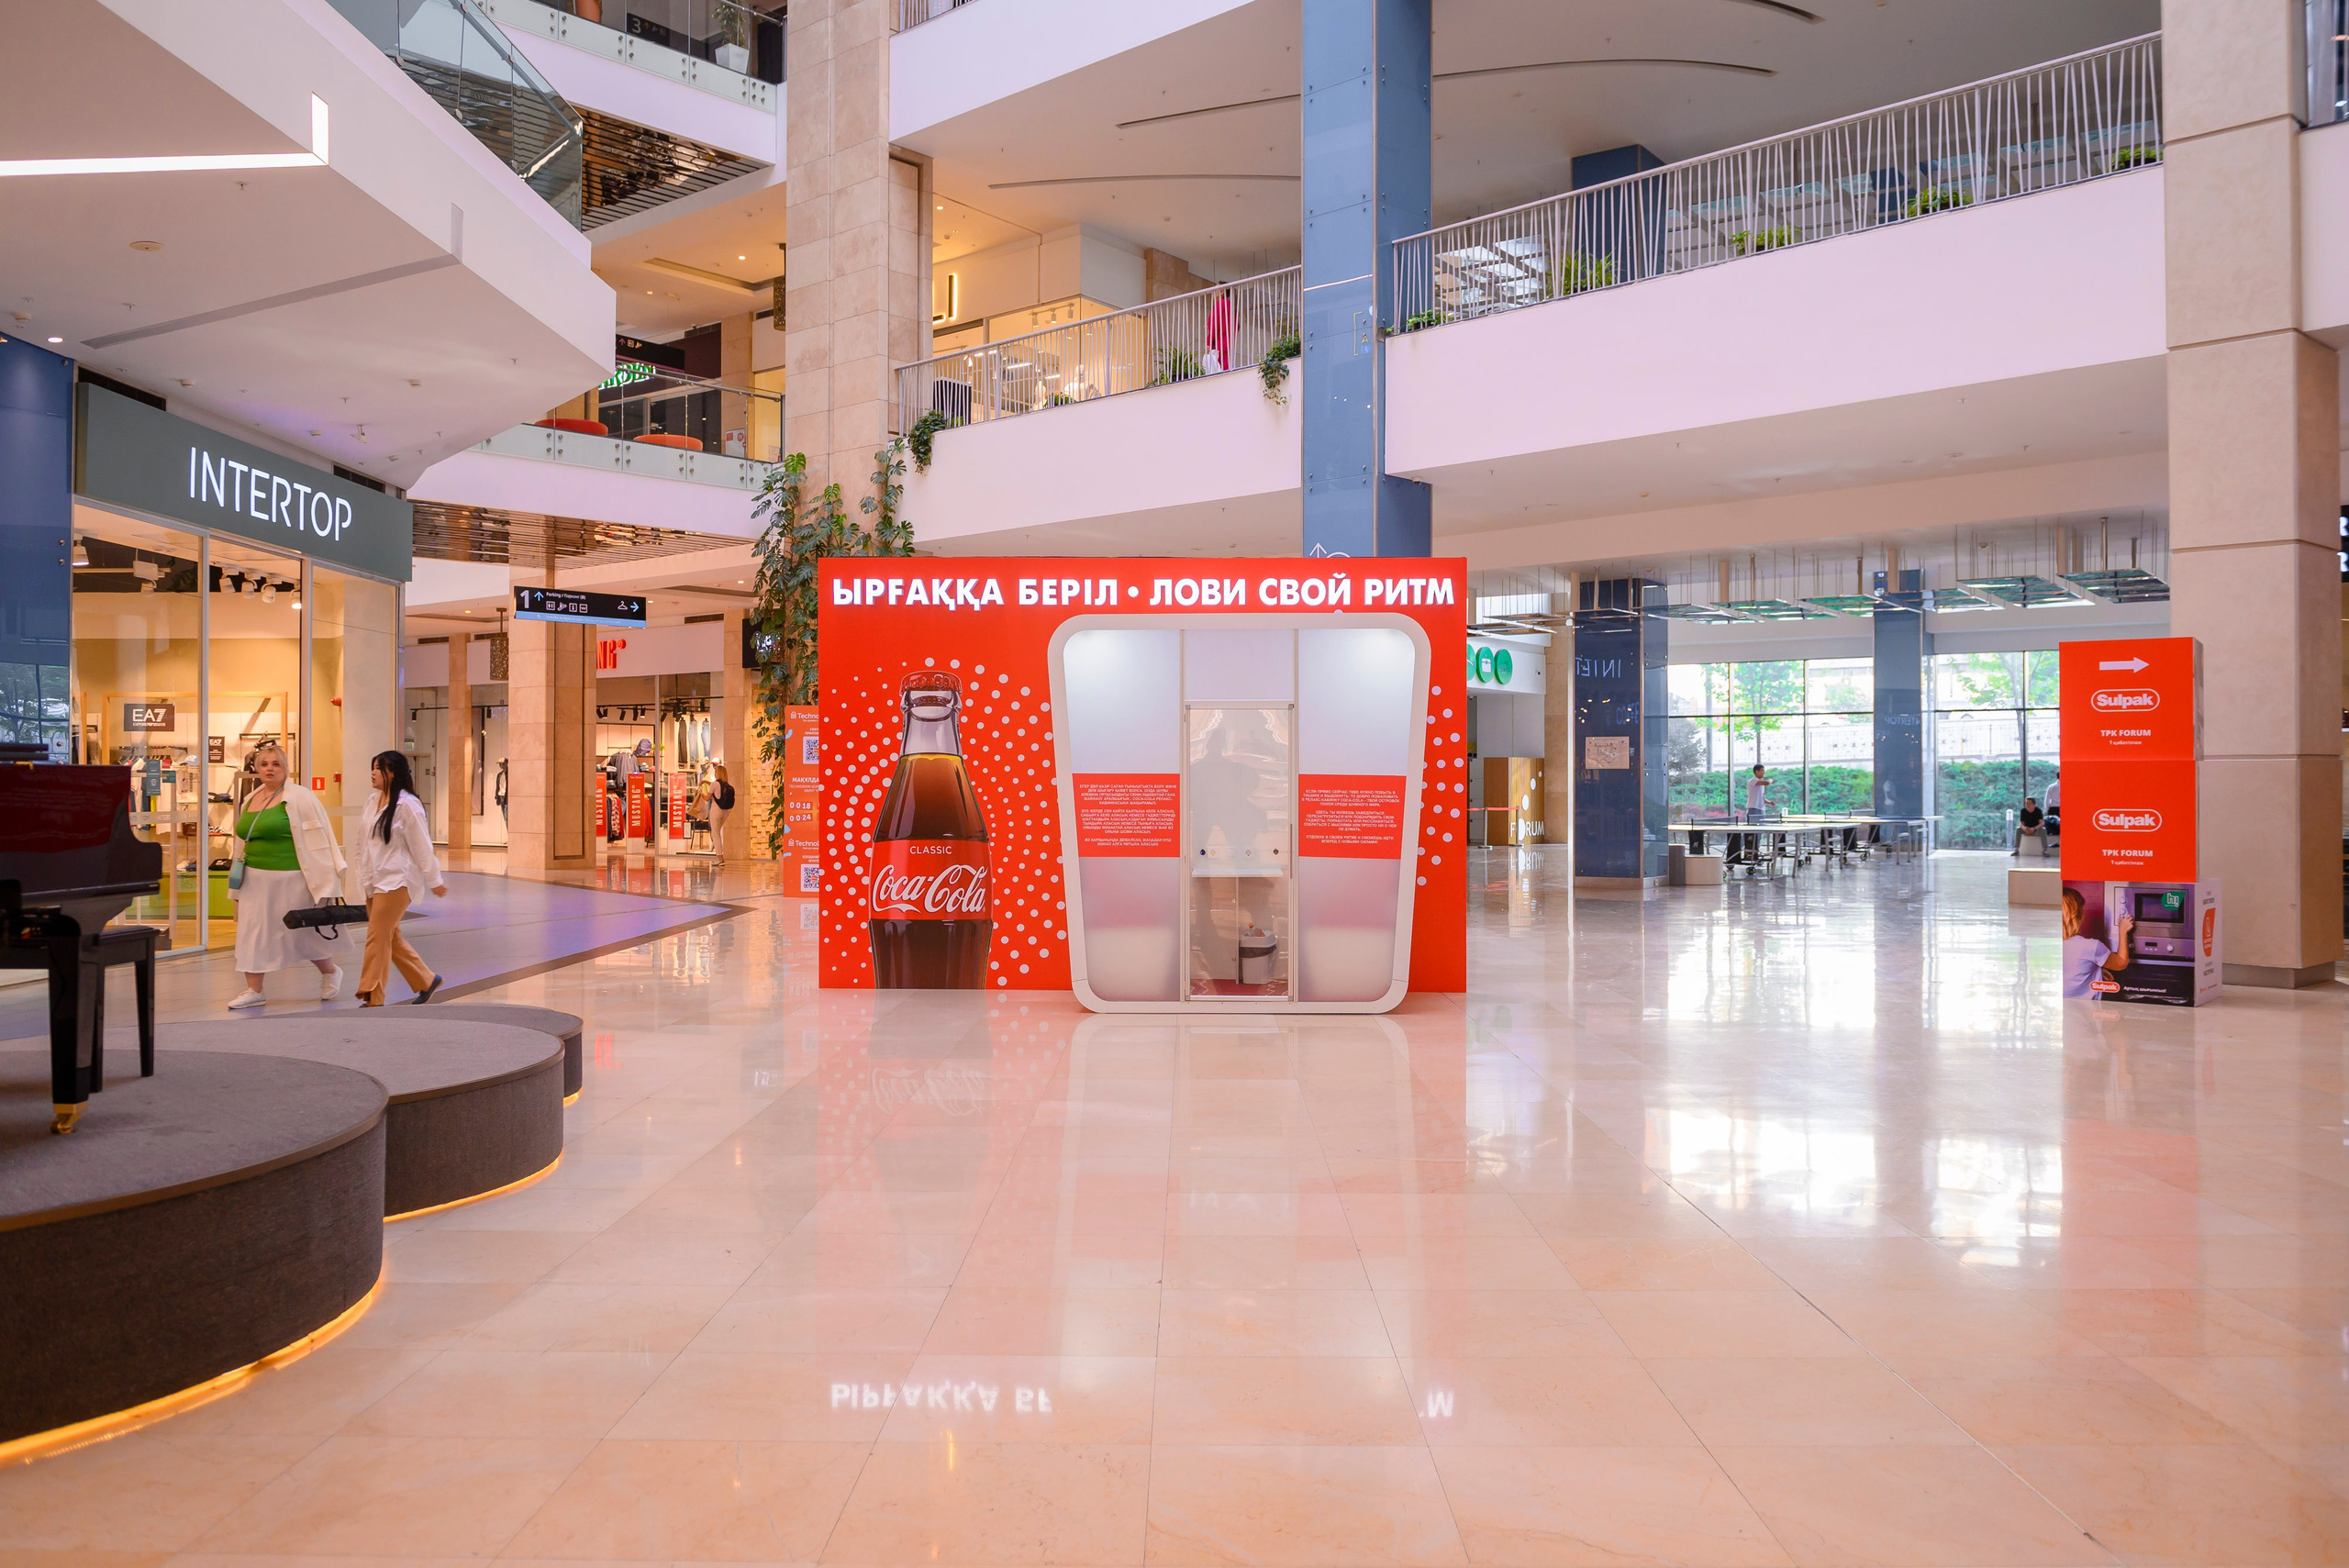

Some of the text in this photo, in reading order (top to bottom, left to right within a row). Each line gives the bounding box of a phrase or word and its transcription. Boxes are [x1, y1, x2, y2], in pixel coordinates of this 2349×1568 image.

[631, 18, 641, 34] 3
[190, 447, 352, 541] INTERTOP
[520, 590, 529, 609] 1
[833, 573, 1454, 611] ЫРҒАҚҚА БЕРІЛ ЛОВИ СВОЙ РИТМ
[2097, 694, 2154, 709] Sulpak
[132, 708, 166, 722] EA7
[631, 789, 641, 827] MUSTANG
[673, 789, 682, 828] MUSTANG
[1510, 818, 1544, 841] FORUM
[2099, 813, 2156, 828] Sulpak
[909, 846, 952, 855] CLASSIC
[873, 864, 988, 913] Coca-Cola
[2091, 983, 2118, 991] Sulpak
